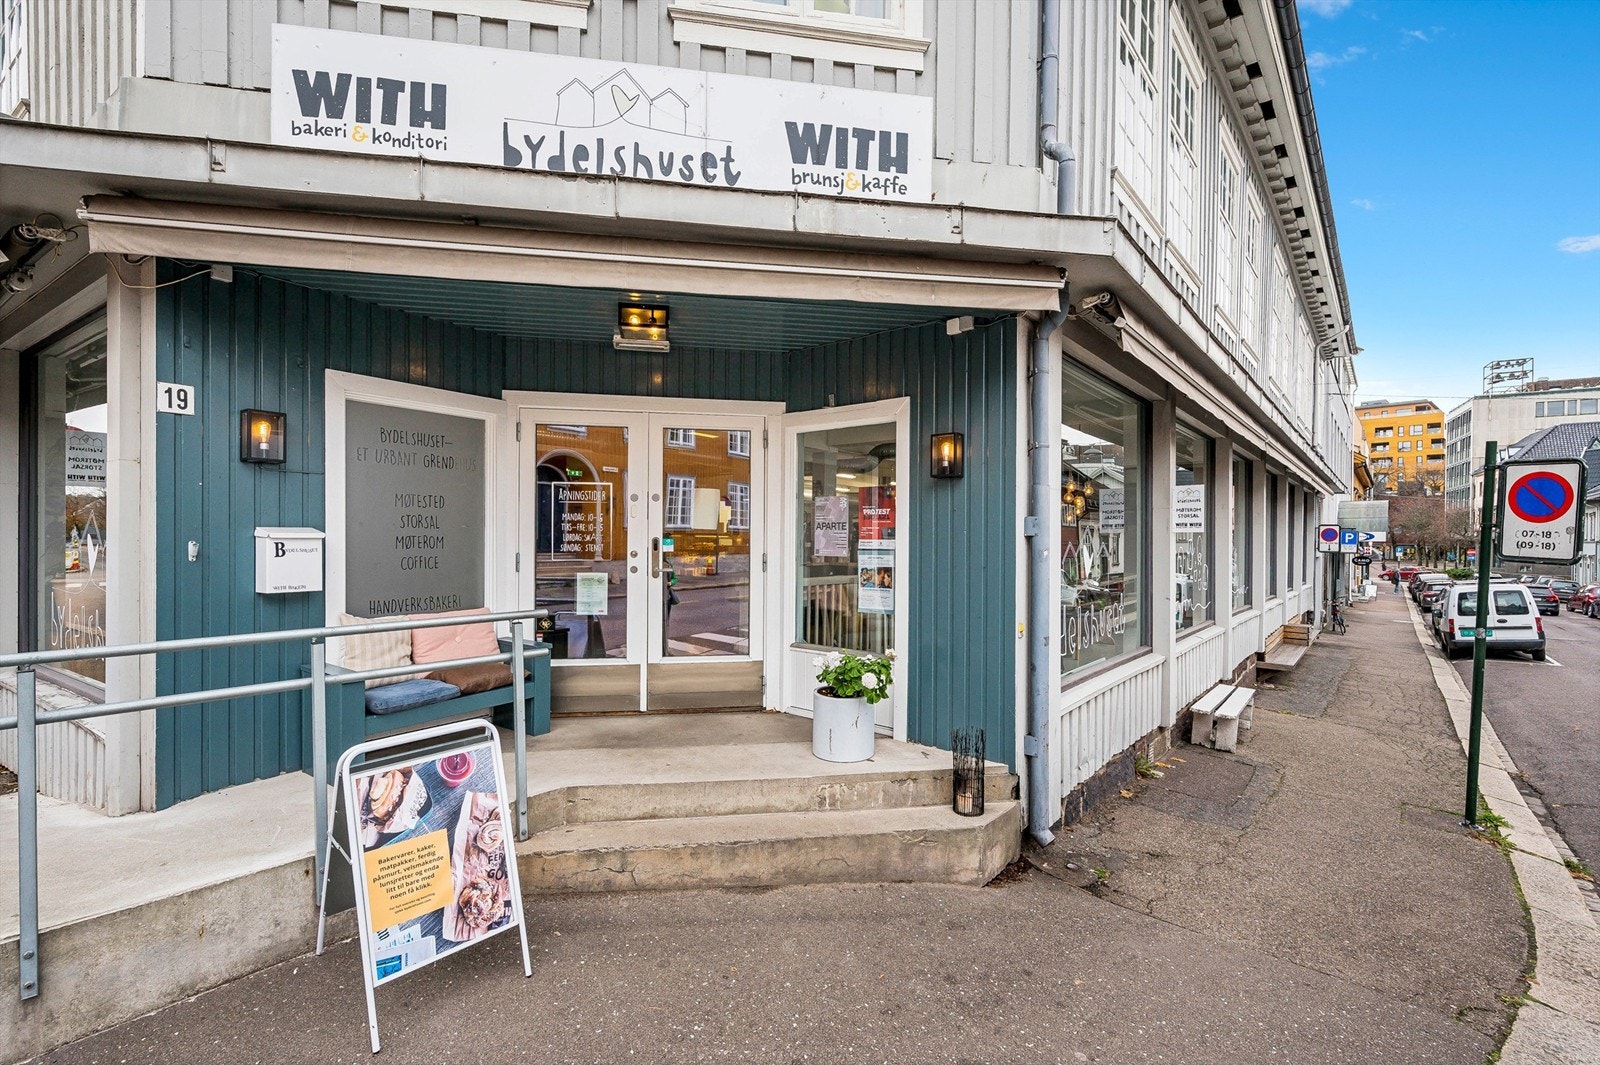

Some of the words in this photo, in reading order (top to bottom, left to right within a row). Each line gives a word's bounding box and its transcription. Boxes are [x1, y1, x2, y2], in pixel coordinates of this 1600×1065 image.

[292, 69, 447, 130] WITH
[291, 120, 347, 138] bakeri
[352, 125, 369, 142] &
[372, 128, 447, 151] konditori
[502, 122, 742, 187] bydelshuset
[784, 121, 909, 174] WITH
[164, 387, 188, 410] 19
[357, 447, 369, 462] ET
[375, 449, 417, 466] URBANT
[395, 493, 445, 509] MØTESTED
[558, 488, 606, 501] ÅPNINGSTIDER
[400, 514, 440, 529] STORSAL
[816, 521, 847, 531] APARTE
[395, 535, 444, 550] MØTEROM
[1345, 533, 1354, 543] P
[1521, 530, 1552, 539] 07-18
[1516, 540, 1556, 551] (09-18)
[400, 556, 440, 570] COFFICE
[369, 594, 462, 615] HANDVERKSBAKERI
[378, 849, 416, 865] Bakervarer,
[416, 843, 436, 853] kaker,
[379, 857, 417, 872] matpakker,
[417, 850, 436, 860] ferdig
[372, 869, 403, 884] påsmurt,
[403, 856, 444, 872] velsmakende
[379, 873, 414, 888] lunsjretter
[423, 864, 440, 873] enda
[386, 885, 396, 894] litt
[397, 882, 405, 890] til
[405, 878, 420, 887] bare
[421, 873, 435, 881] med
[390, 891, 407, 900] noen
[407, 886, 415, 894] få
[415, 882, 433, 891] klikk.
